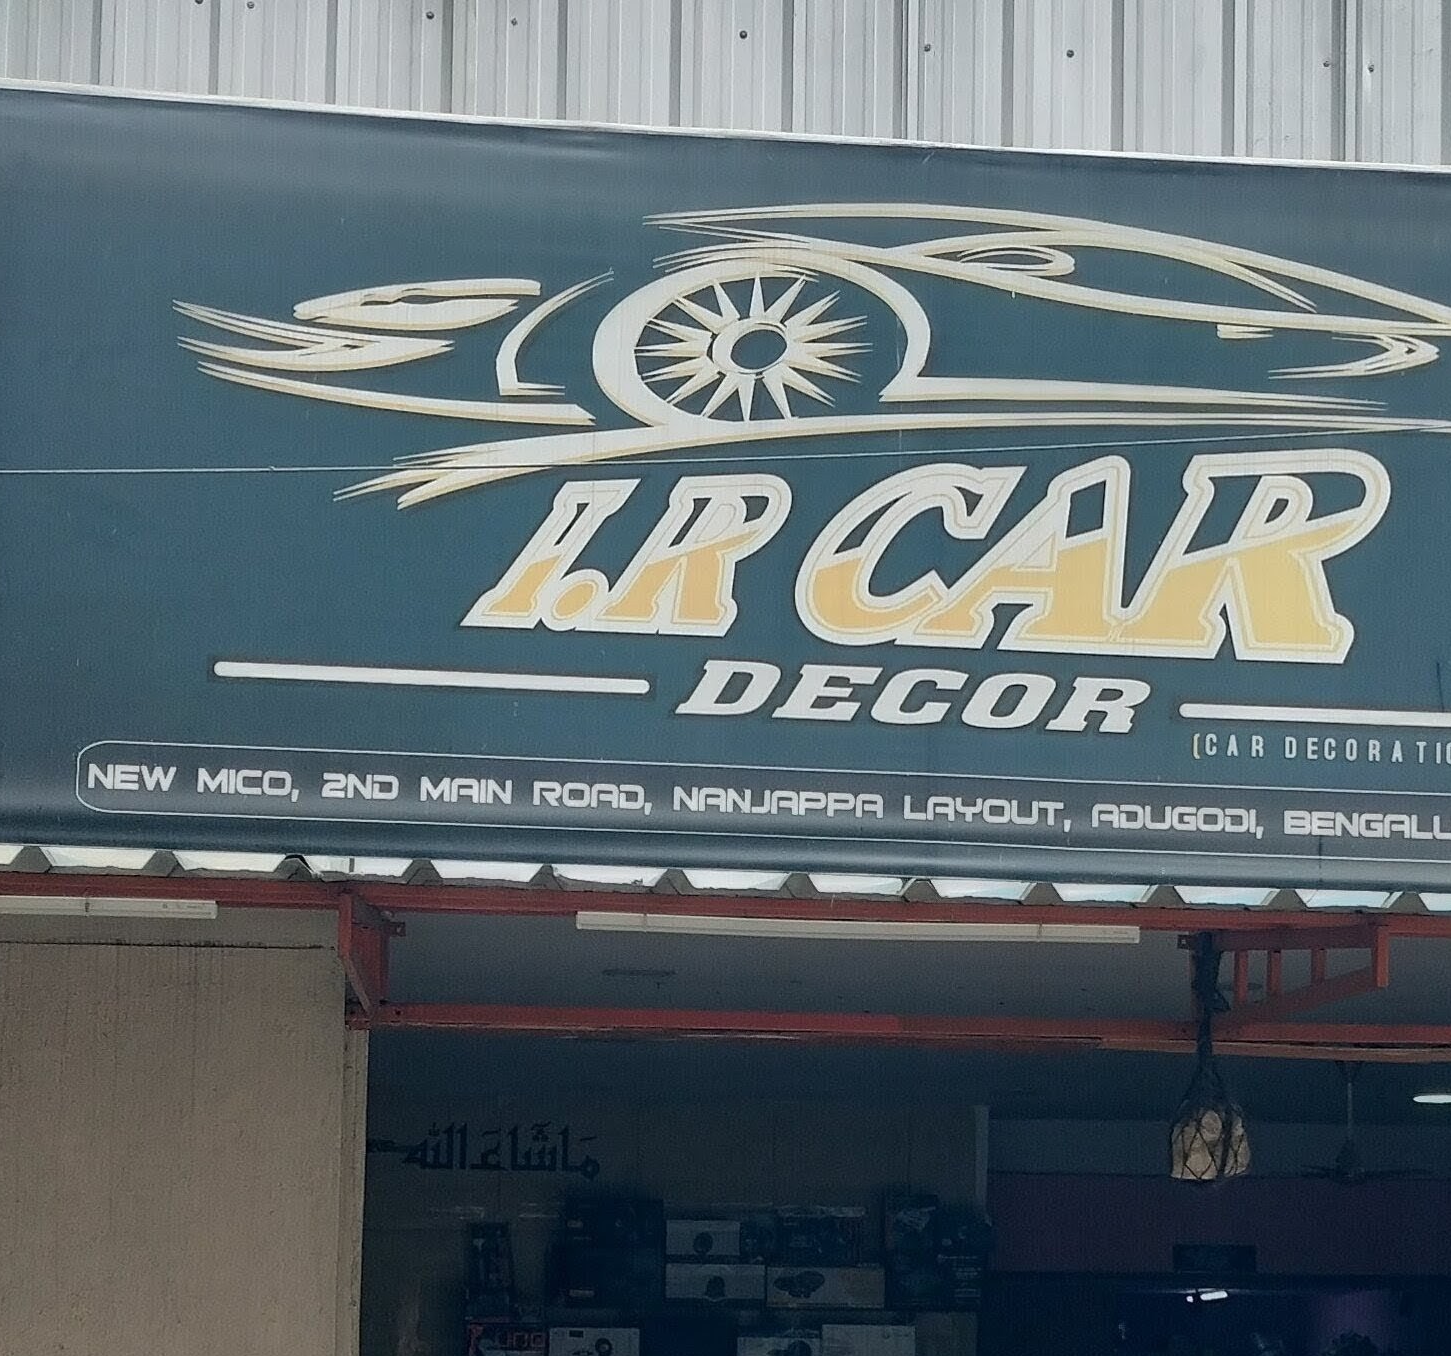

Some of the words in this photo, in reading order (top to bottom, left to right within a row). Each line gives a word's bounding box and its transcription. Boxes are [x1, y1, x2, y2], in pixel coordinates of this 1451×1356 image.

[461, 474, 794, 637] I.R
[793, 448, 1391, 663] CAR
[673, 658, 1153, 735] DECOR
[88, 763, 176, 793] NEW
[196, 767, 299, 803] MICO,
[321, 772, 399, 800] 2ND
[420, 776, 512, 805] MAIN
[533, 780, 653, 817] ROAD,
[673, 786, 884, 819] NANJAPPA
[904, 794, 1071, 834] LAYOUT,
[1092, 803, 1264, 840] ADUGODI,
